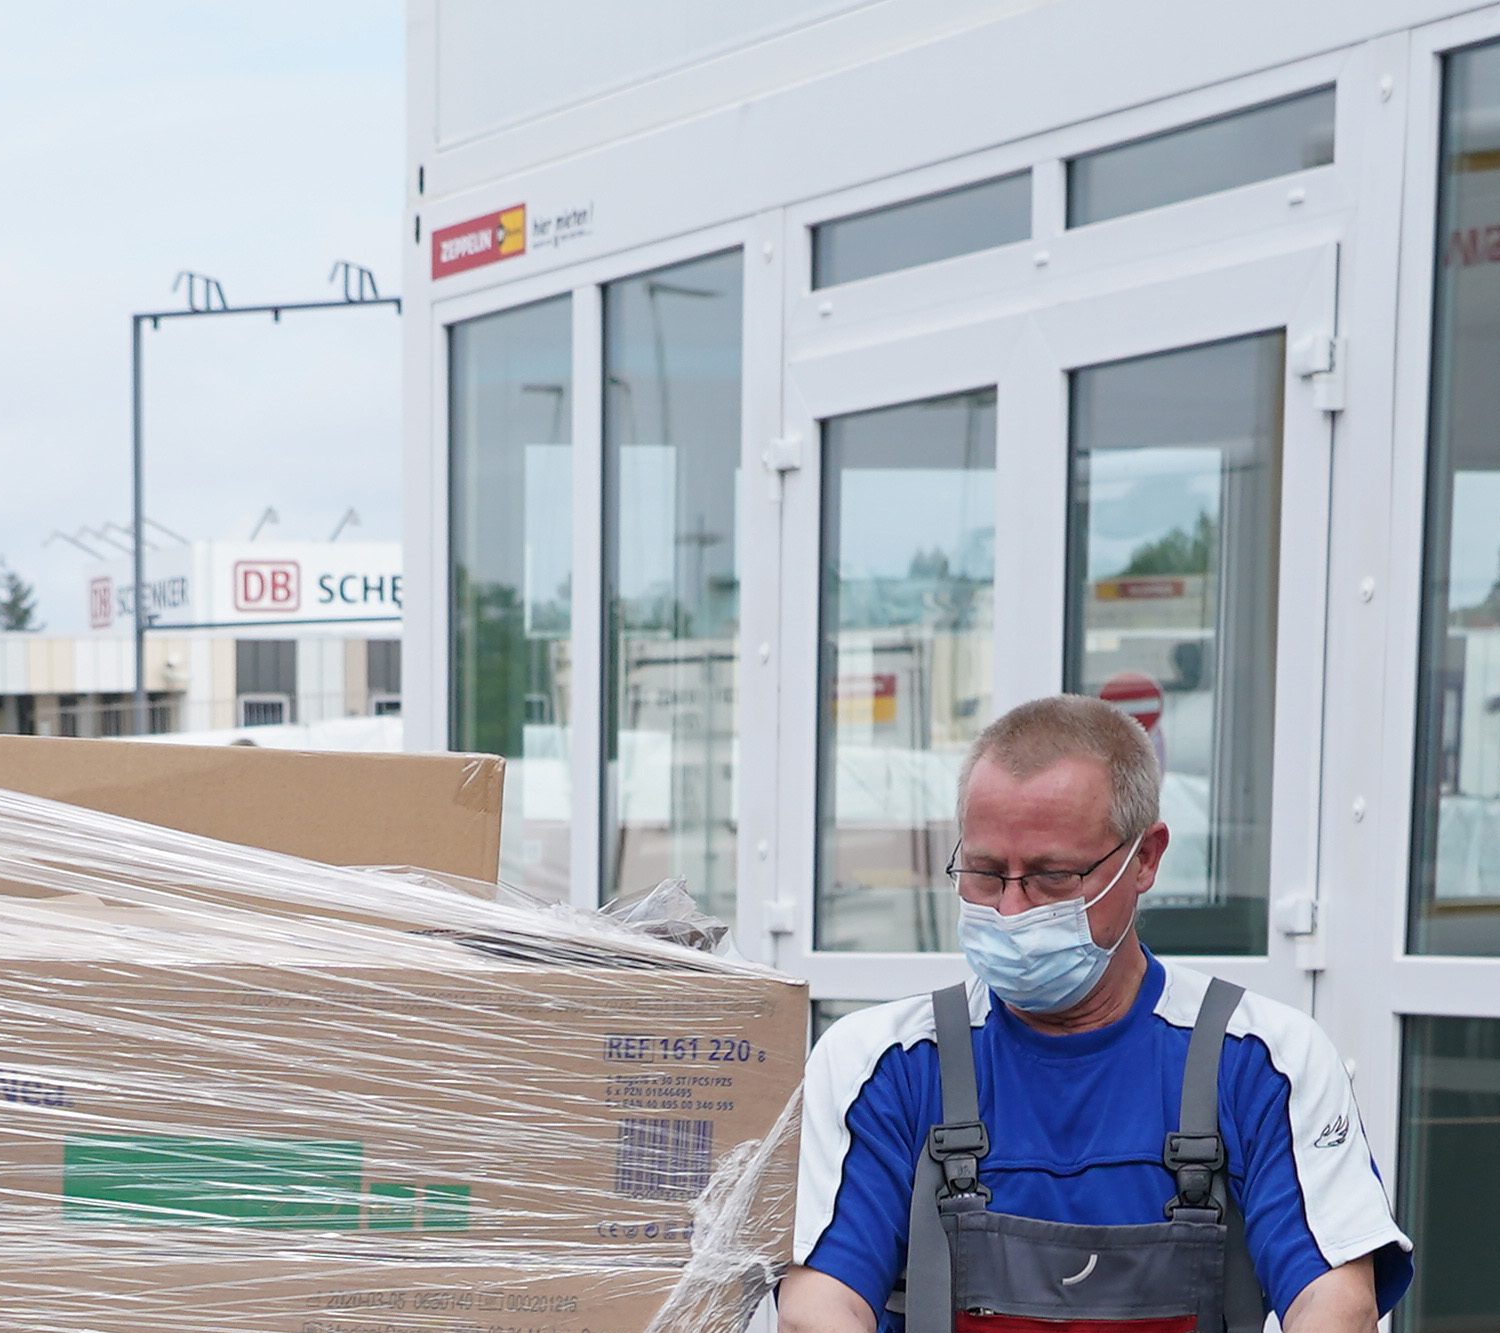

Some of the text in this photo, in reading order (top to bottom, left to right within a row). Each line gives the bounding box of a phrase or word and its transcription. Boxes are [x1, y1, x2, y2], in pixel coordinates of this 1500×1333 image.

[243, 570, 291, 603] DB
[608, 1037, 751, 1063] REF 161 220
